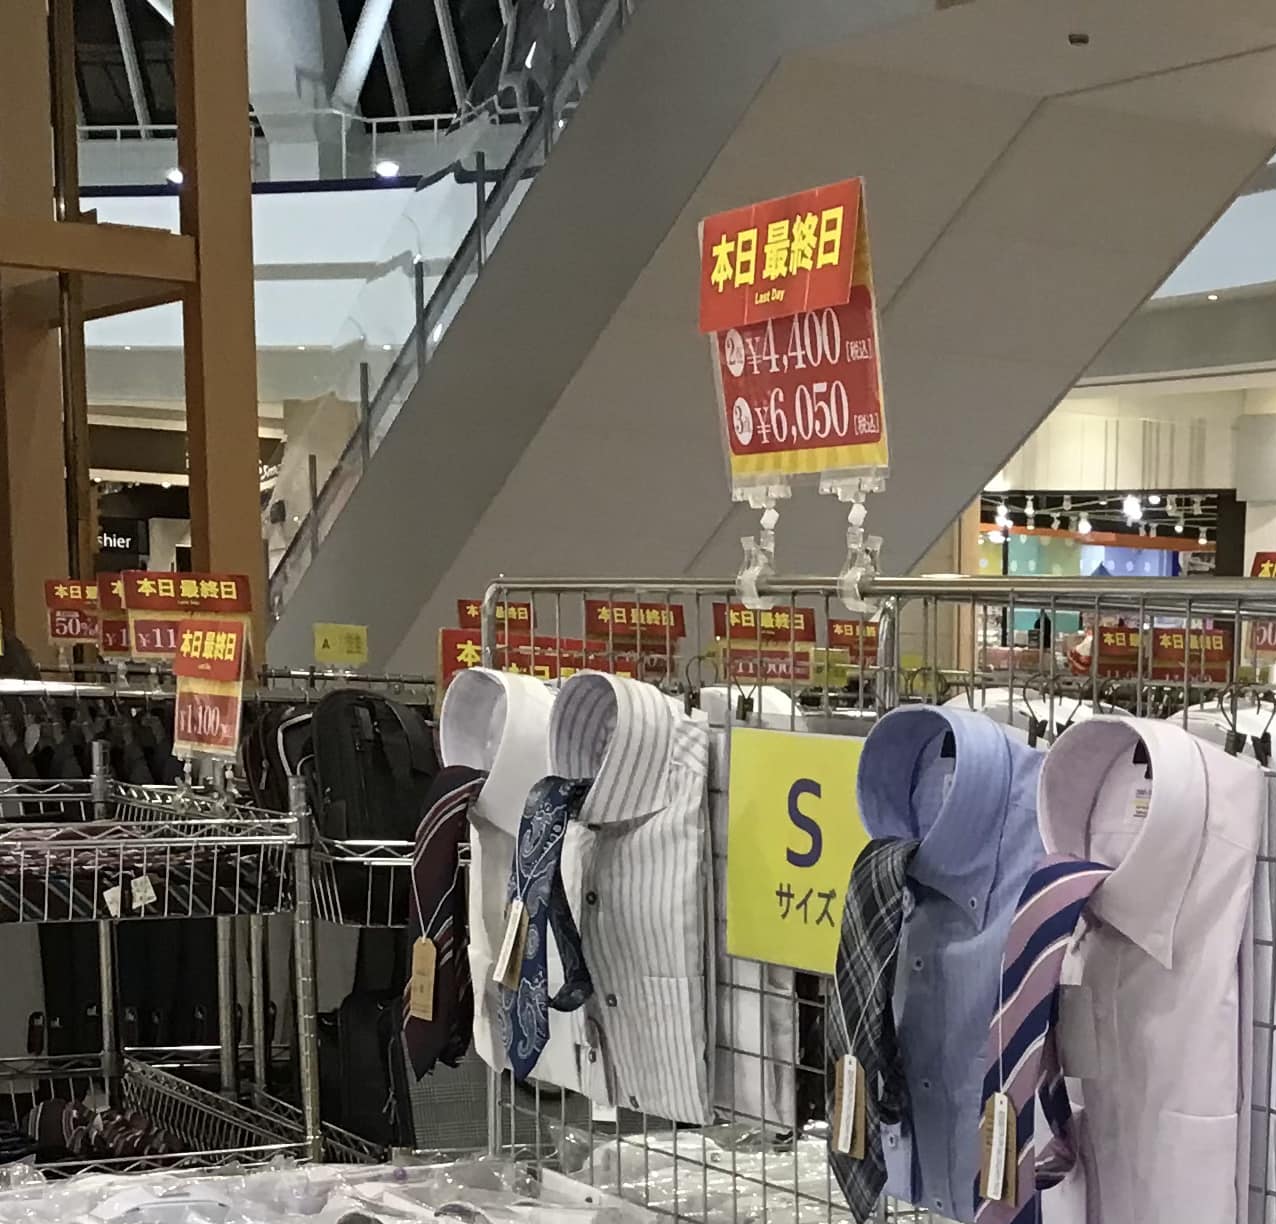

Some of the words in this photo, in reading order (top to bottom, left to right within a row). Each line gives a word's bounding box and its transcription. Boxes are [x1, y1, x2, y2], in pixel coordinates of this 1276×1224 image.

[711, 228, 757, 292] 本日
[762, 206, 844, 280] 最終日
[755, 291, 770, 304] Last
[771, 288, 785, 302] Day
[747, 308, 841, 374] ¥4,400
[756, 380, 849, 443] ¥6,050
[54, 584, 82, 599] 本日
[136, 578, 175, 597] 本日
[180, 579, 237, 599] 最終日
[598, 607, 627, 624] 本日
[180, 630, 202, 658] 本日
[203, 631, 236, 661] 最終日
[786, 778, 823, 868] S
[776, 883, 837, 927] サイズ
